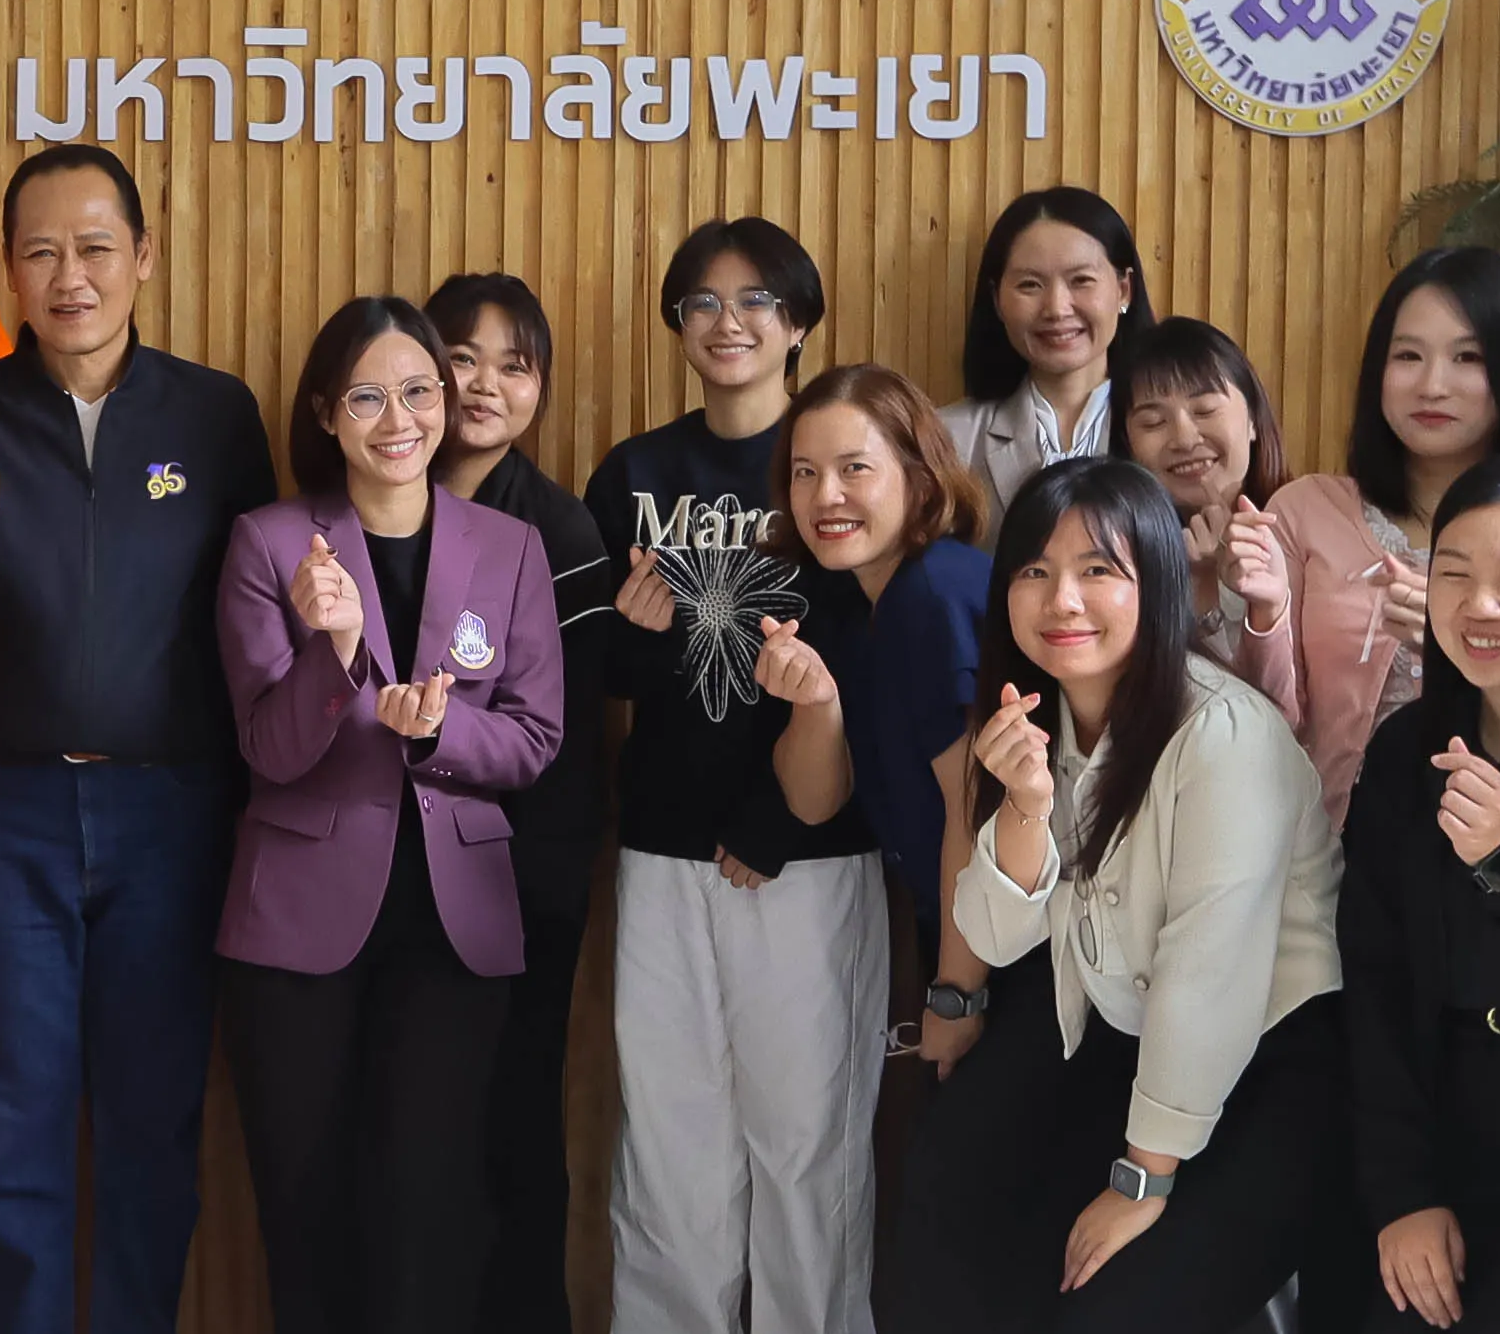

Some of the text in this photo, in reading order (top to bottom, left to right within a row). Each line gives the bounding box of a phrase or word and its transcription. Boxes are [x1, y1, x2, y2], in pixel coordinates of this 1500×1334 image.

[15, 19, 1049, 143] มหาวิทยาลัยพะเยา
[1173, 30, 1435, 127] UNIVERSITY OF PHAYAO
[1190, 10, 1416, 104] มหาวิทยาลัยพะเยา
